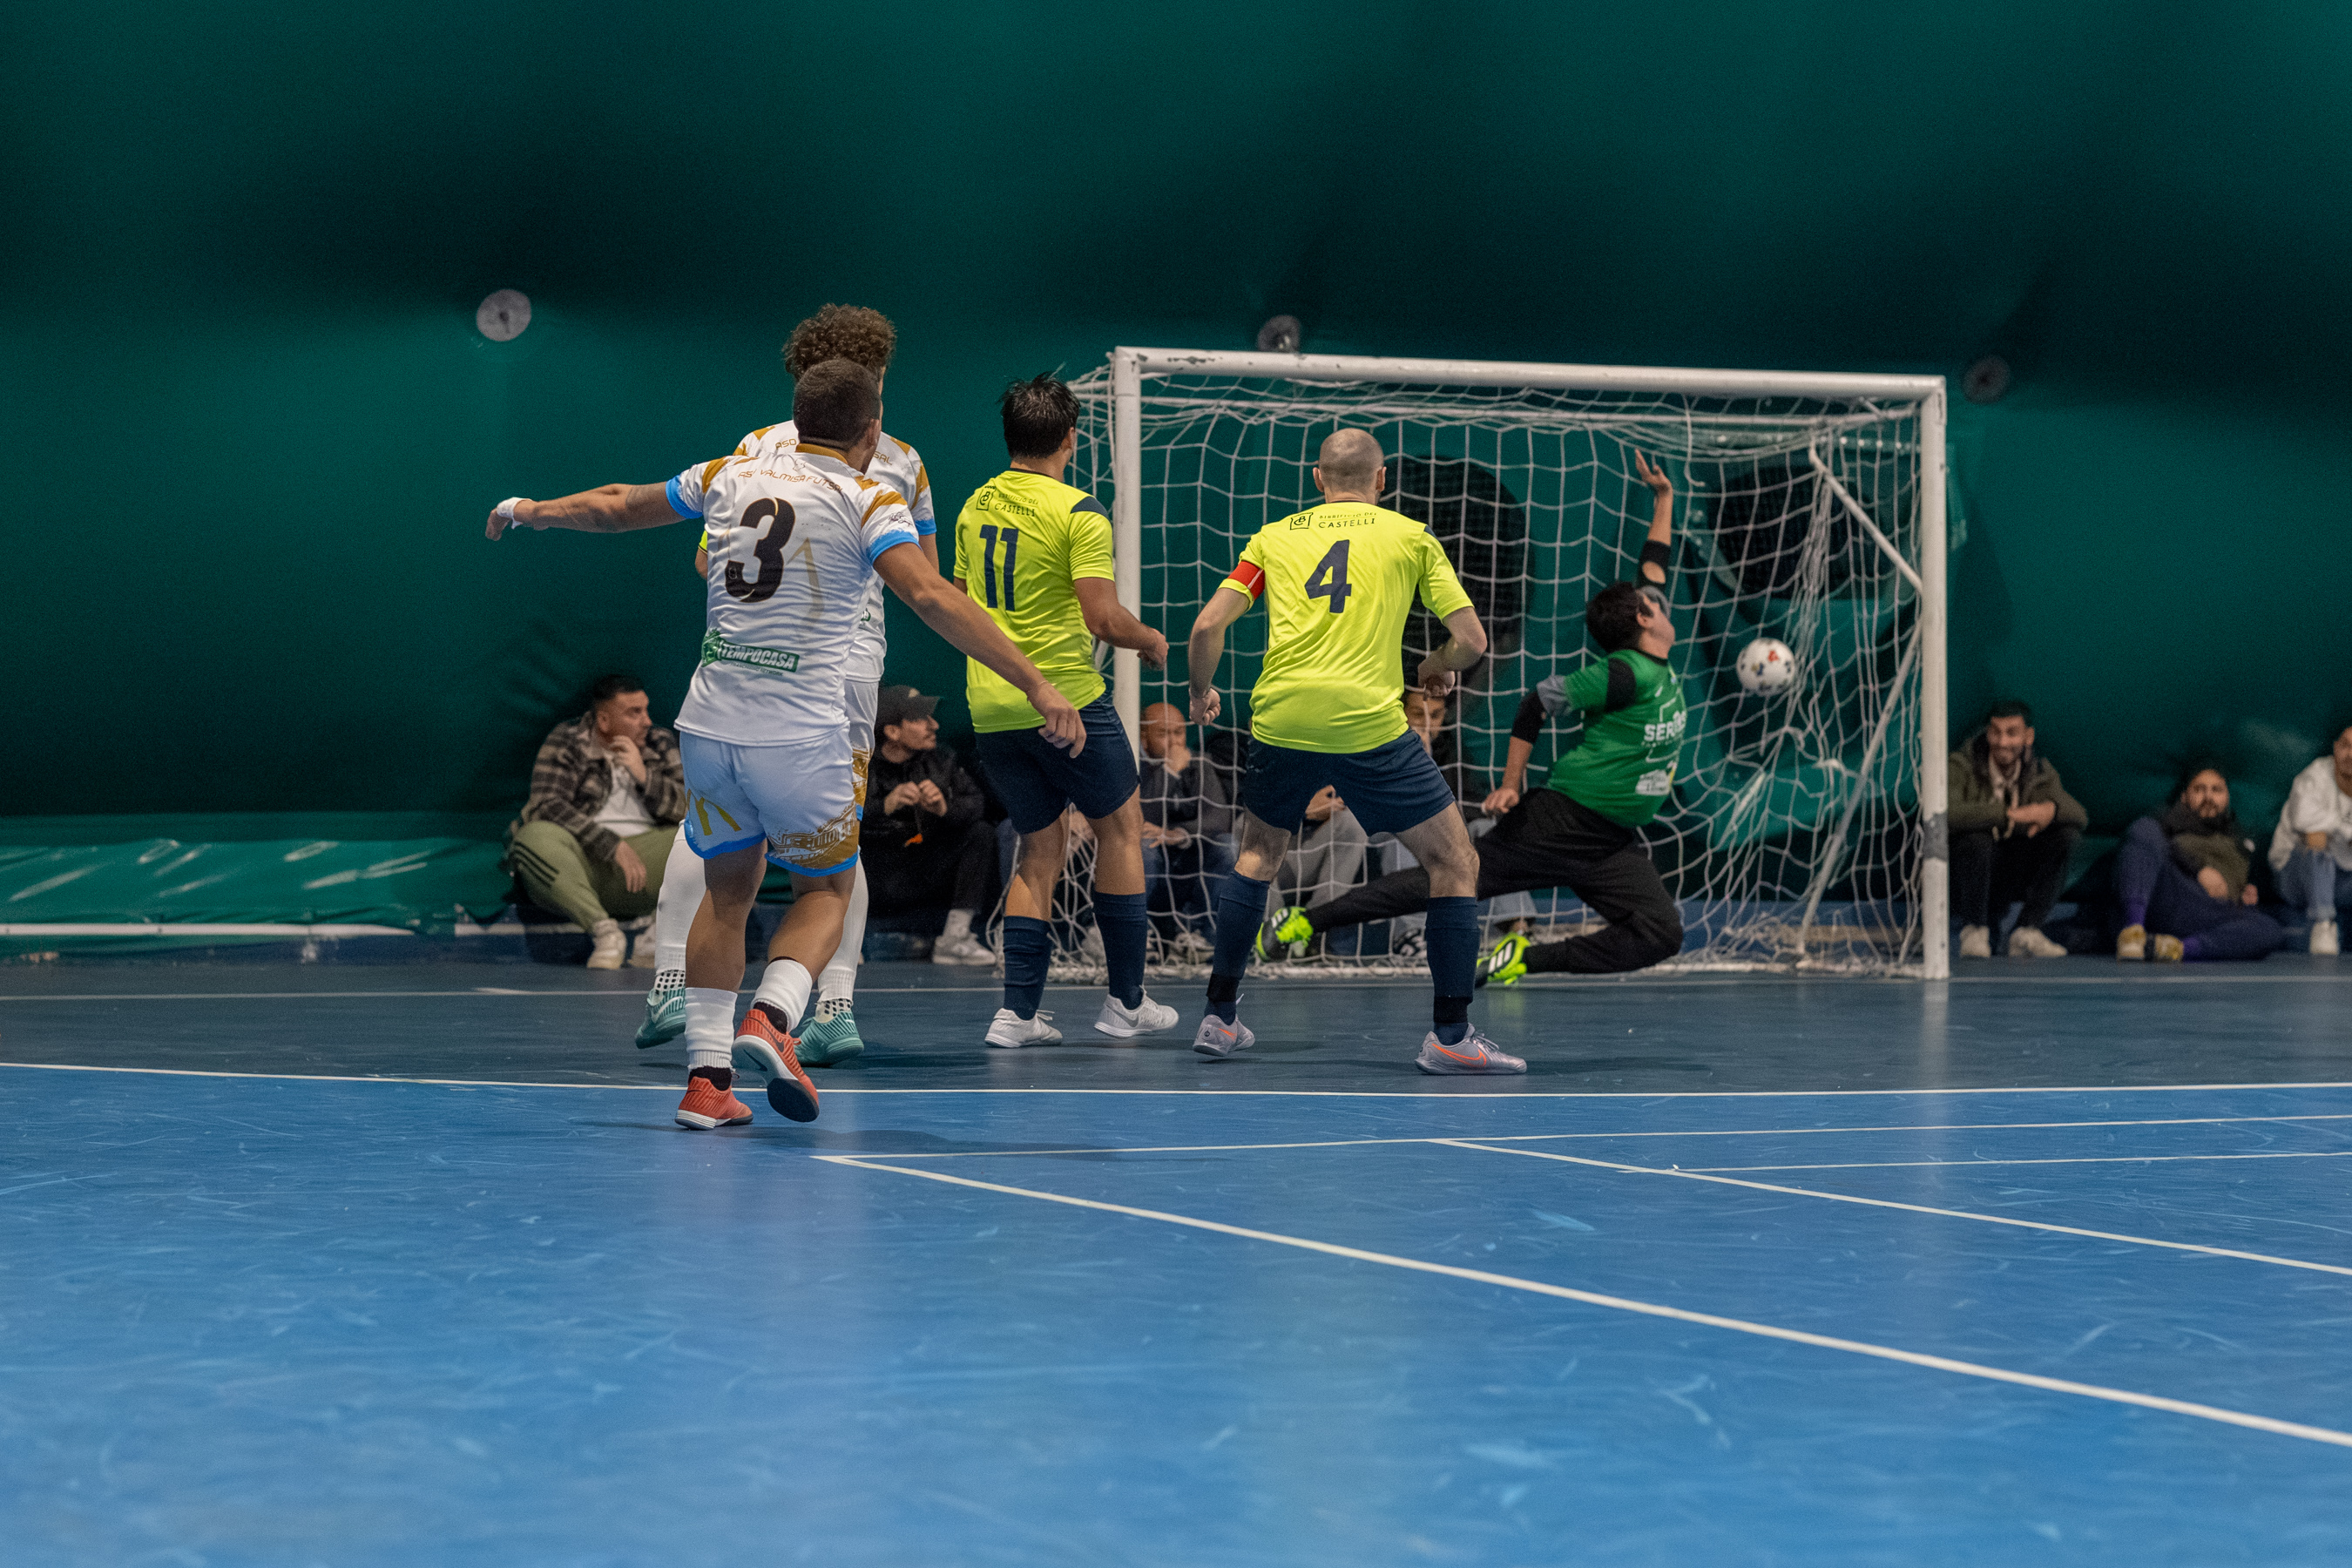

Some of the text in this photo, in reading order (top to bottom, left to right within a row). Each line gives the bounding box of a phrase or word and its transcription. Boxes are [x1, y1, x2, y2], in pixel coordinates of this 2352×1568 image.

[873, 451, 893, 465] SAL
[760, 470, 806, 483] VALMISA
[1318, 517, 1375, 529] CASTELLI
[725, 497, 796, 603] 3
[979, 524, 1019, 612] 11
[1304, 539, 1352, 613] 4
[721, 644, 796, 670] TEMPOCASA
